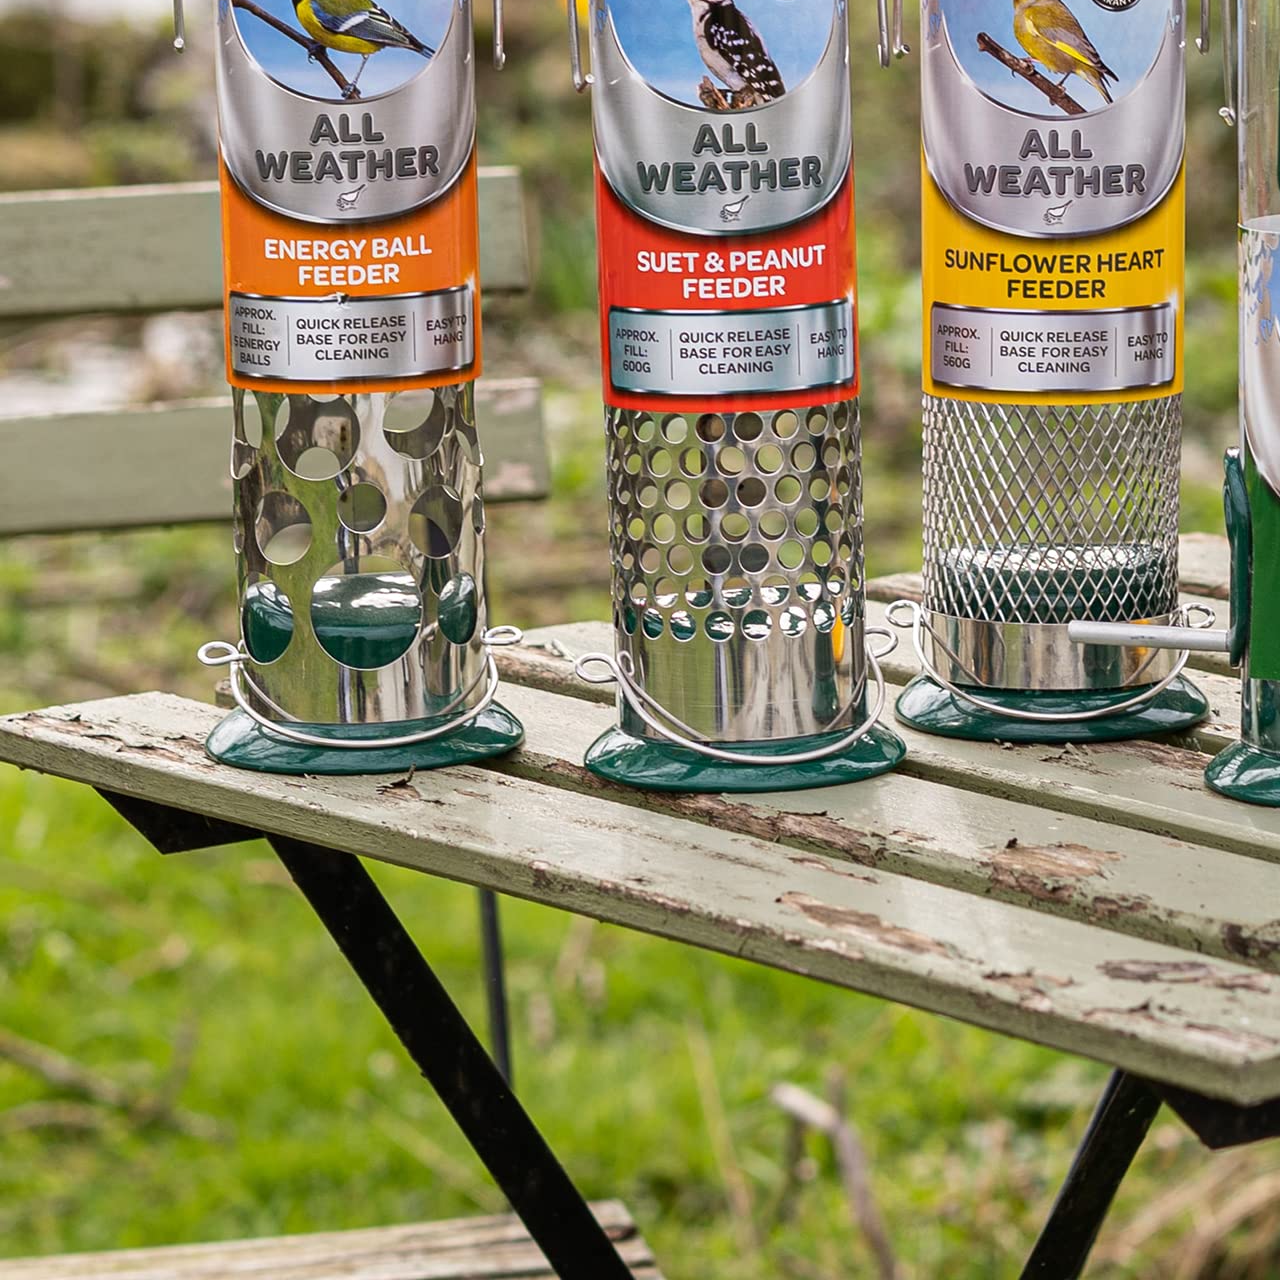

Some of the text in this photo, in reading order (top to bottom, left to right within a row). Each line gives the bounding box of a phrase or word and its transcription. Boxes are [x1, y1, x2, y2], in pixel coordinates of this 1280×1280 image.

[309, 112, 385, 144] ALL
[693, 122, 769, 155] ALL
[1019, 129, 1093, 159] ALL
[255, 146, 440, 181] WEATHER
[637, 156, 821, 192] WEATHER
[964, 163, 1145, 196] WEATHER
[264, 235, 432, 260] ENERGY BALL
[637, 245, 826, 273] SUET & PEANUT
[944, 249, 1164, 274] SUNFLOWER HEART
[298, 263, 400, 286] FEEDER
[682, 275, 786, 299] FEEDER
[1007, 279, 1106, 299] FEEDER
[235, 308, 277, 321] APPROX.
[242, 322, 265, 335] FILL:
[296, 316, 406, 331] QUICK RELEASE
[426, 315, 467, 331] EASY TO
[297, 331, 407, 346] BASE FOR EASY
[433, 333, 463, 346] HANG
[616, 328, 659, 342] APPROX.
[679, 329, 790, 344] QUICK RELEASE
[810, 328, 848, 345] EASY TO
[937, 324, 980, 340] APPROX.
[1000, 331, 1108, 343] QUICK RELEASE
[1128, 332, 1168, 347] EASY TO
[239, 336, 280, 351] ENERGY
[944, 341, 969, 354] FILL:
[240, 352, 270, 366] BALLS
[315, 348, 389, 361] CLEANING
[624, 345, 648, 358] FILL:
[680, 344, 791, 359] BASE FOR EASY
[817, 345, 844, 359] HANG
[1000, 346, 1108, 358] BASE FOR EASY
[1134, 349, 1163, 361] HANG
[623, 360, 651, 373] 600G
[699, 361, 773, 375] CLEANING
[943, 355, 970, 369] 560G
[1018, 361, 1090, 373] CLEANING
